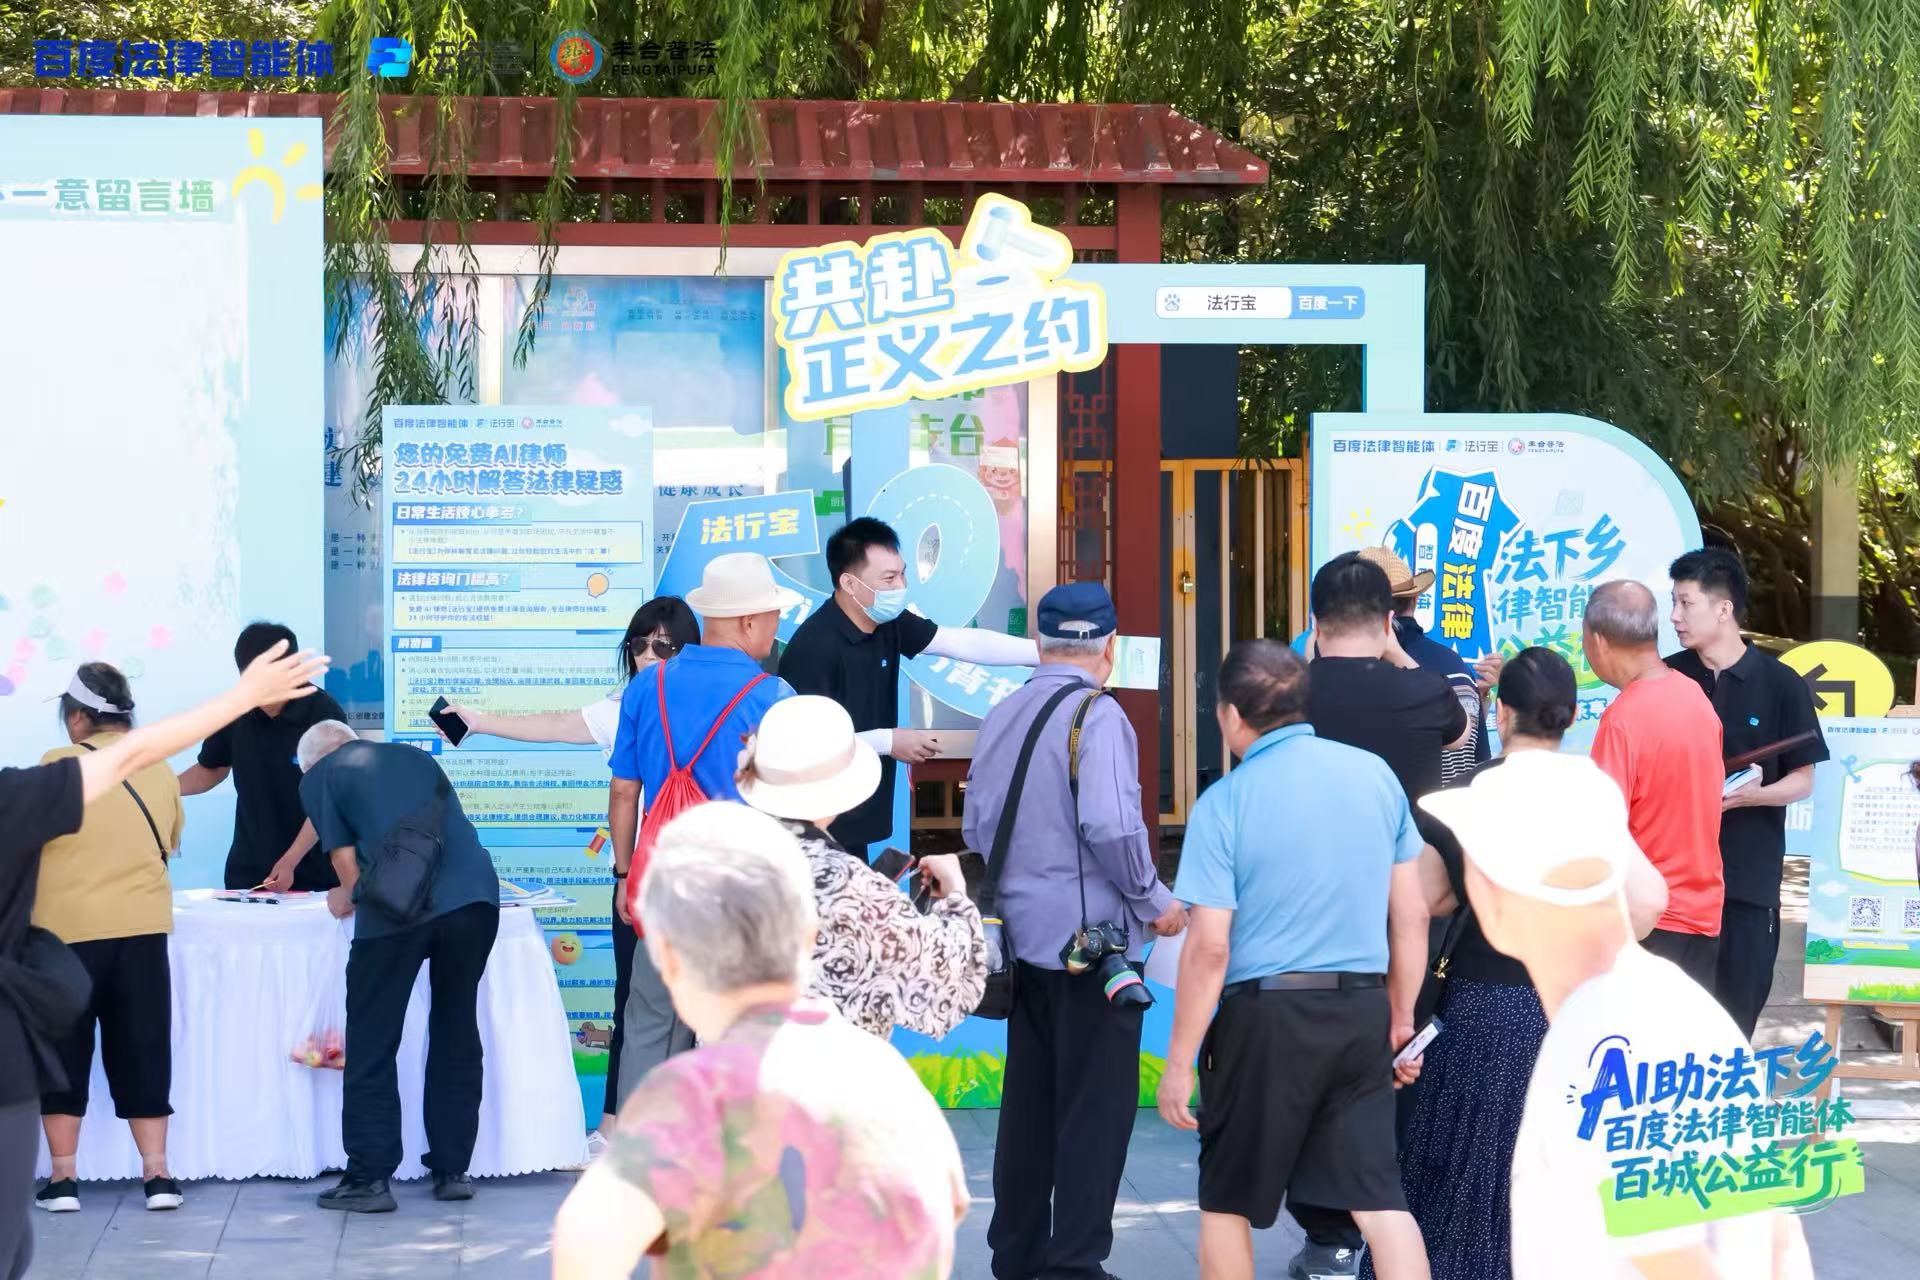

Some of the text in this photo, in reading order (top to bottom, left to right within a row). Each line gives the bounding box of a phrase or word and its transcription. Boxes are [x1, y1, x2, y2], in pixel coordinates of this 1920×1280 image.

[0, 178, 214, 213] 一意留言墙
[781, 235, 955, 340] 共赴
[1207, 294, 1358, 312] 法行宝 百度一下
[802, 297, 1091, 405] 正义之约
[394, 443, 568, 468] 您的免费AI律师
[1332, 439, 1436, 453] 百度法律智能体
[1465, 440, 1499, 453] 法行宝
[394, 470, 624, 496] 24小时解答法律疑惑
[700, 507, 801, 545] 法行宝
[1440, 481, 1496, 640] 百度法律
[1495, 513, 1627, 584] 法下乡
